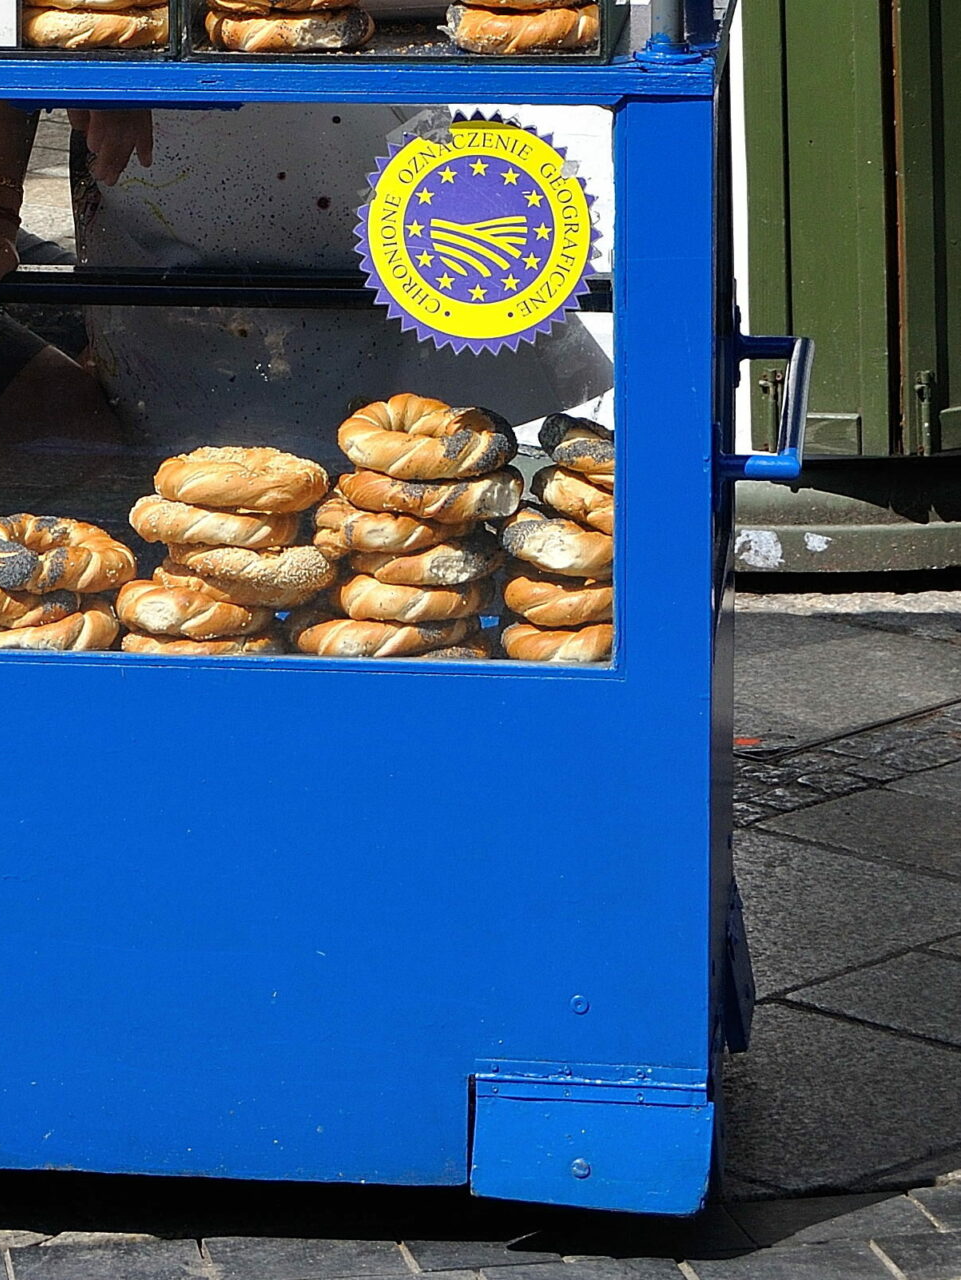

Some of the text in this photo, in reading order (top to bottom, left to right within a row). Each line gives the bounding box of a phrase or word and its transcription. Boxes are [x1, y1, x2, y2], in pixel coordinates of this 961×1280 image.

[380, 132, 580, 318] CHRONIONE OZNACZENIE GEOGRAFICZNE
